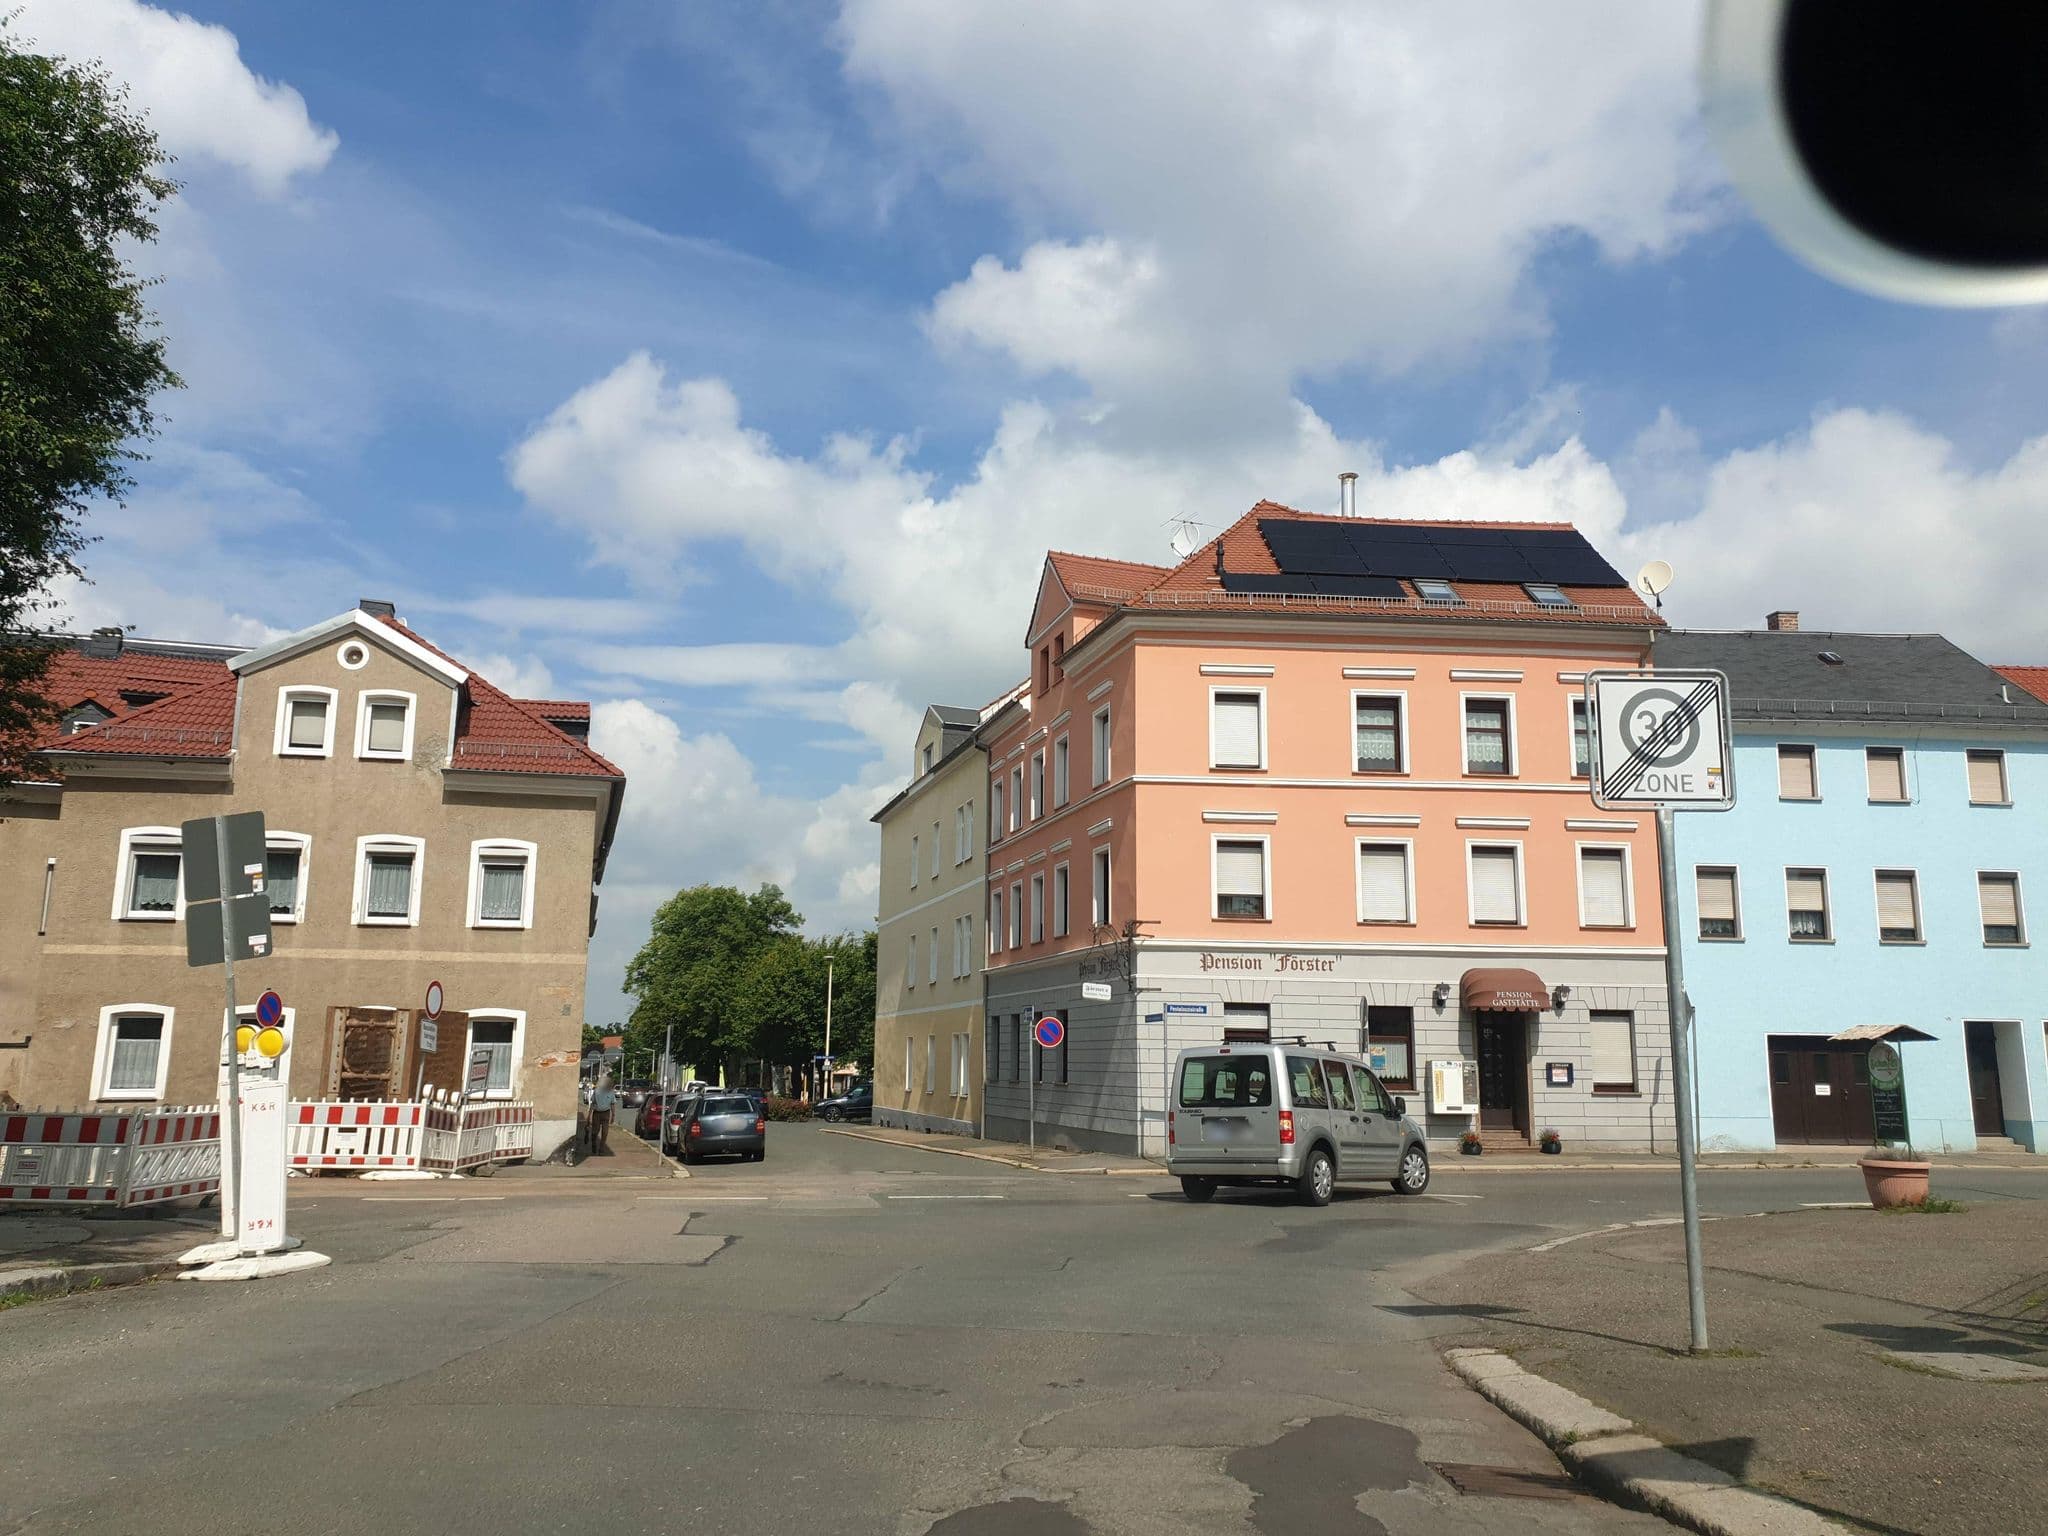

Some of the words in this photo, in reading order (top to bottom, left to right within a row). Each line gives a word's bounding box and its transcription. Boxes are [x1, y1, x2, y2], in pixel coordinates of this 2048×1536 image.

[1634, 773, 1694, 793] ZONE
[1200, 952, 1262, 971] Pension
[1269, 952, 1342, 972] "Förster"
